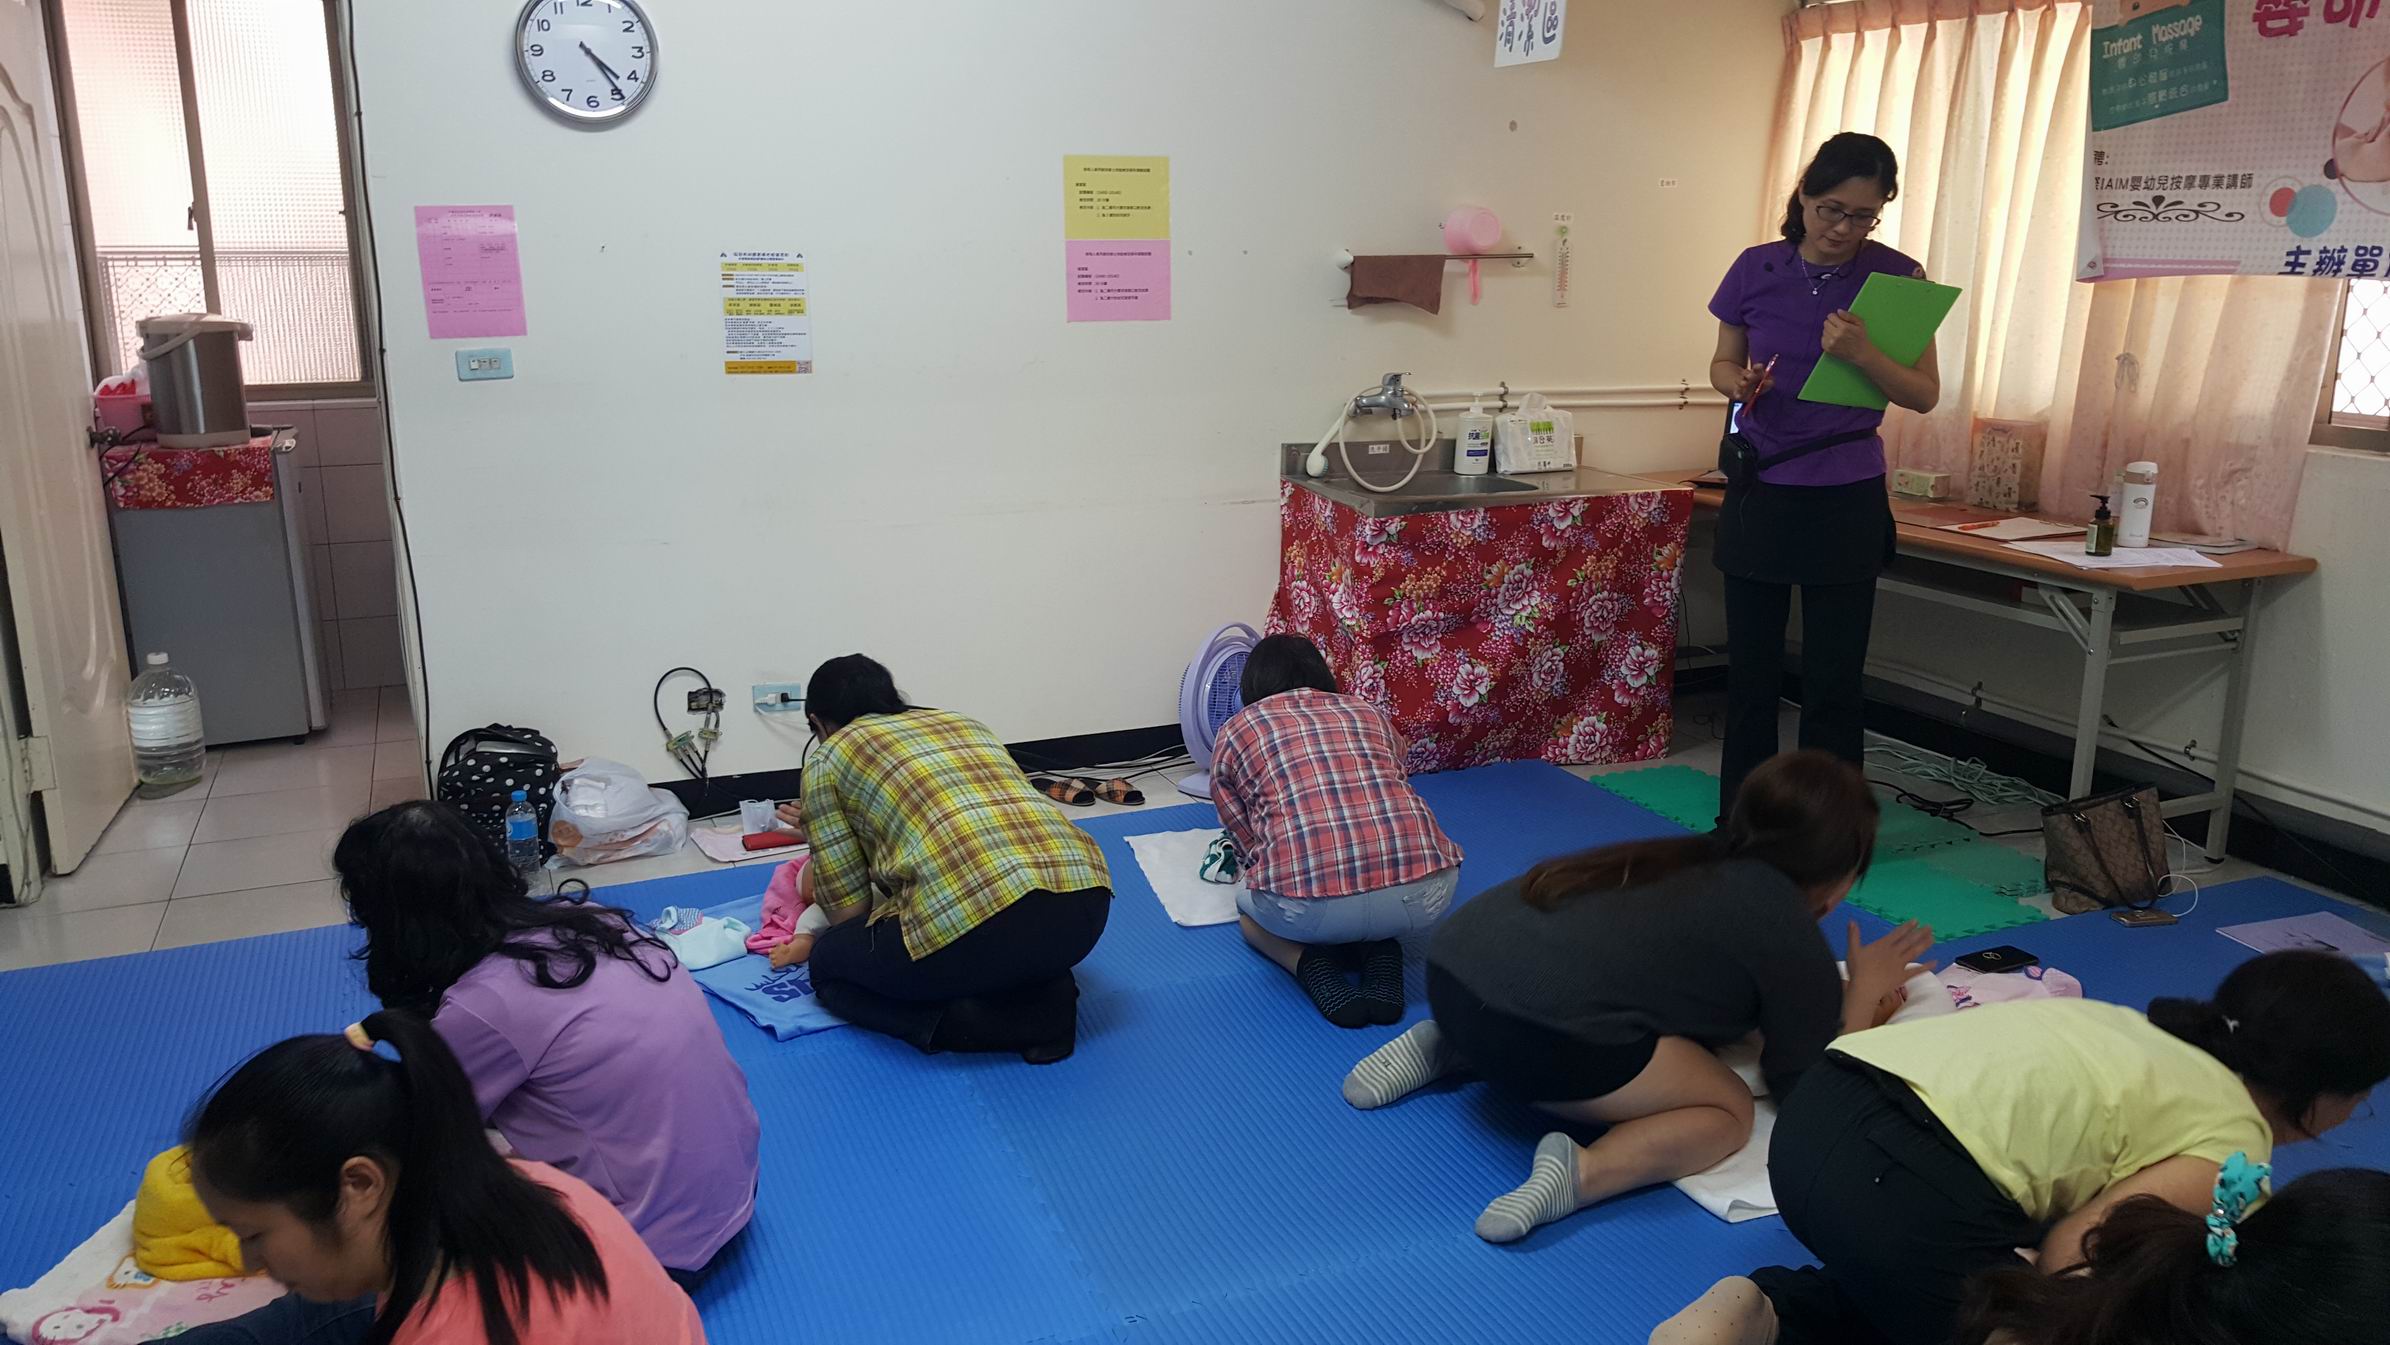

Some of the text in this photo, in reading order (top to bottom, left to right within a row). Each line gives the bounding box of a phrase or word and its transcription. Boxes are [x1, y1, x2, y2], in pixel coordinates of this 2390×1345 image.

[554, 2, 564, 15] 11
[537, 18, 551, 32] 10
[622, 20, 635, 33] 2
[2102, 32, 2143, 59] Infant
[2152, 14, 2203, 45] Massage
[530, 44, 545, 57] 9
[631, 46, 645, 59] 3
[541, 69, 556, 83] 8
[627, 69, 639, 83] 4
[561, 88, 573, 102] 7
[610, 88, 624, 101] 5
[586, 95, 600, 108] 6
[2277, 244, 2390, 278] 主辦單
